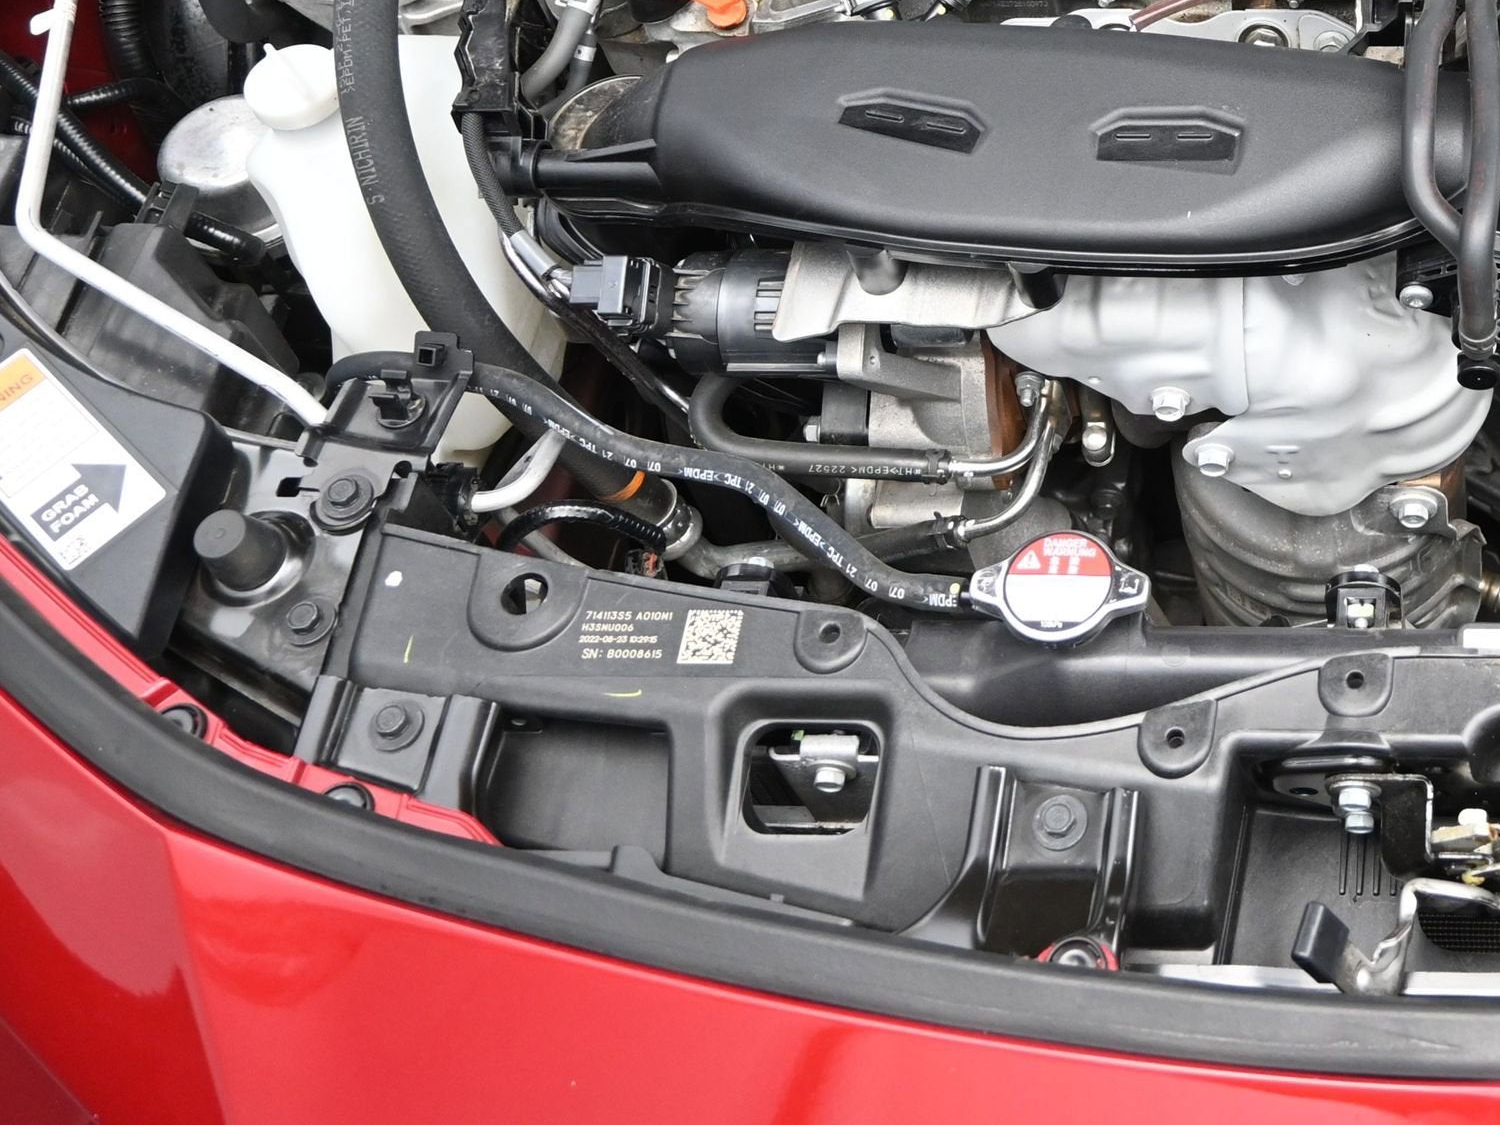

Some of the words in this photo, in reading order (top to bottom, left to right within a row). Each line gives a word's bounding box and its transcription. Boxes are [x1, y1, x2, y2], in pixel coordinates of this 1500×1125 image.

[579, 438, 598, 454] TPC
[808, 464, 846, 473] 22527
[723, 472, 743, 489] TPC
[41, 484, 89, 522] GRAB
[50, 493, 100, 533] FOAM
[826, 546, 845, 569] TPC
[581, 648, 603, 659] SN:
